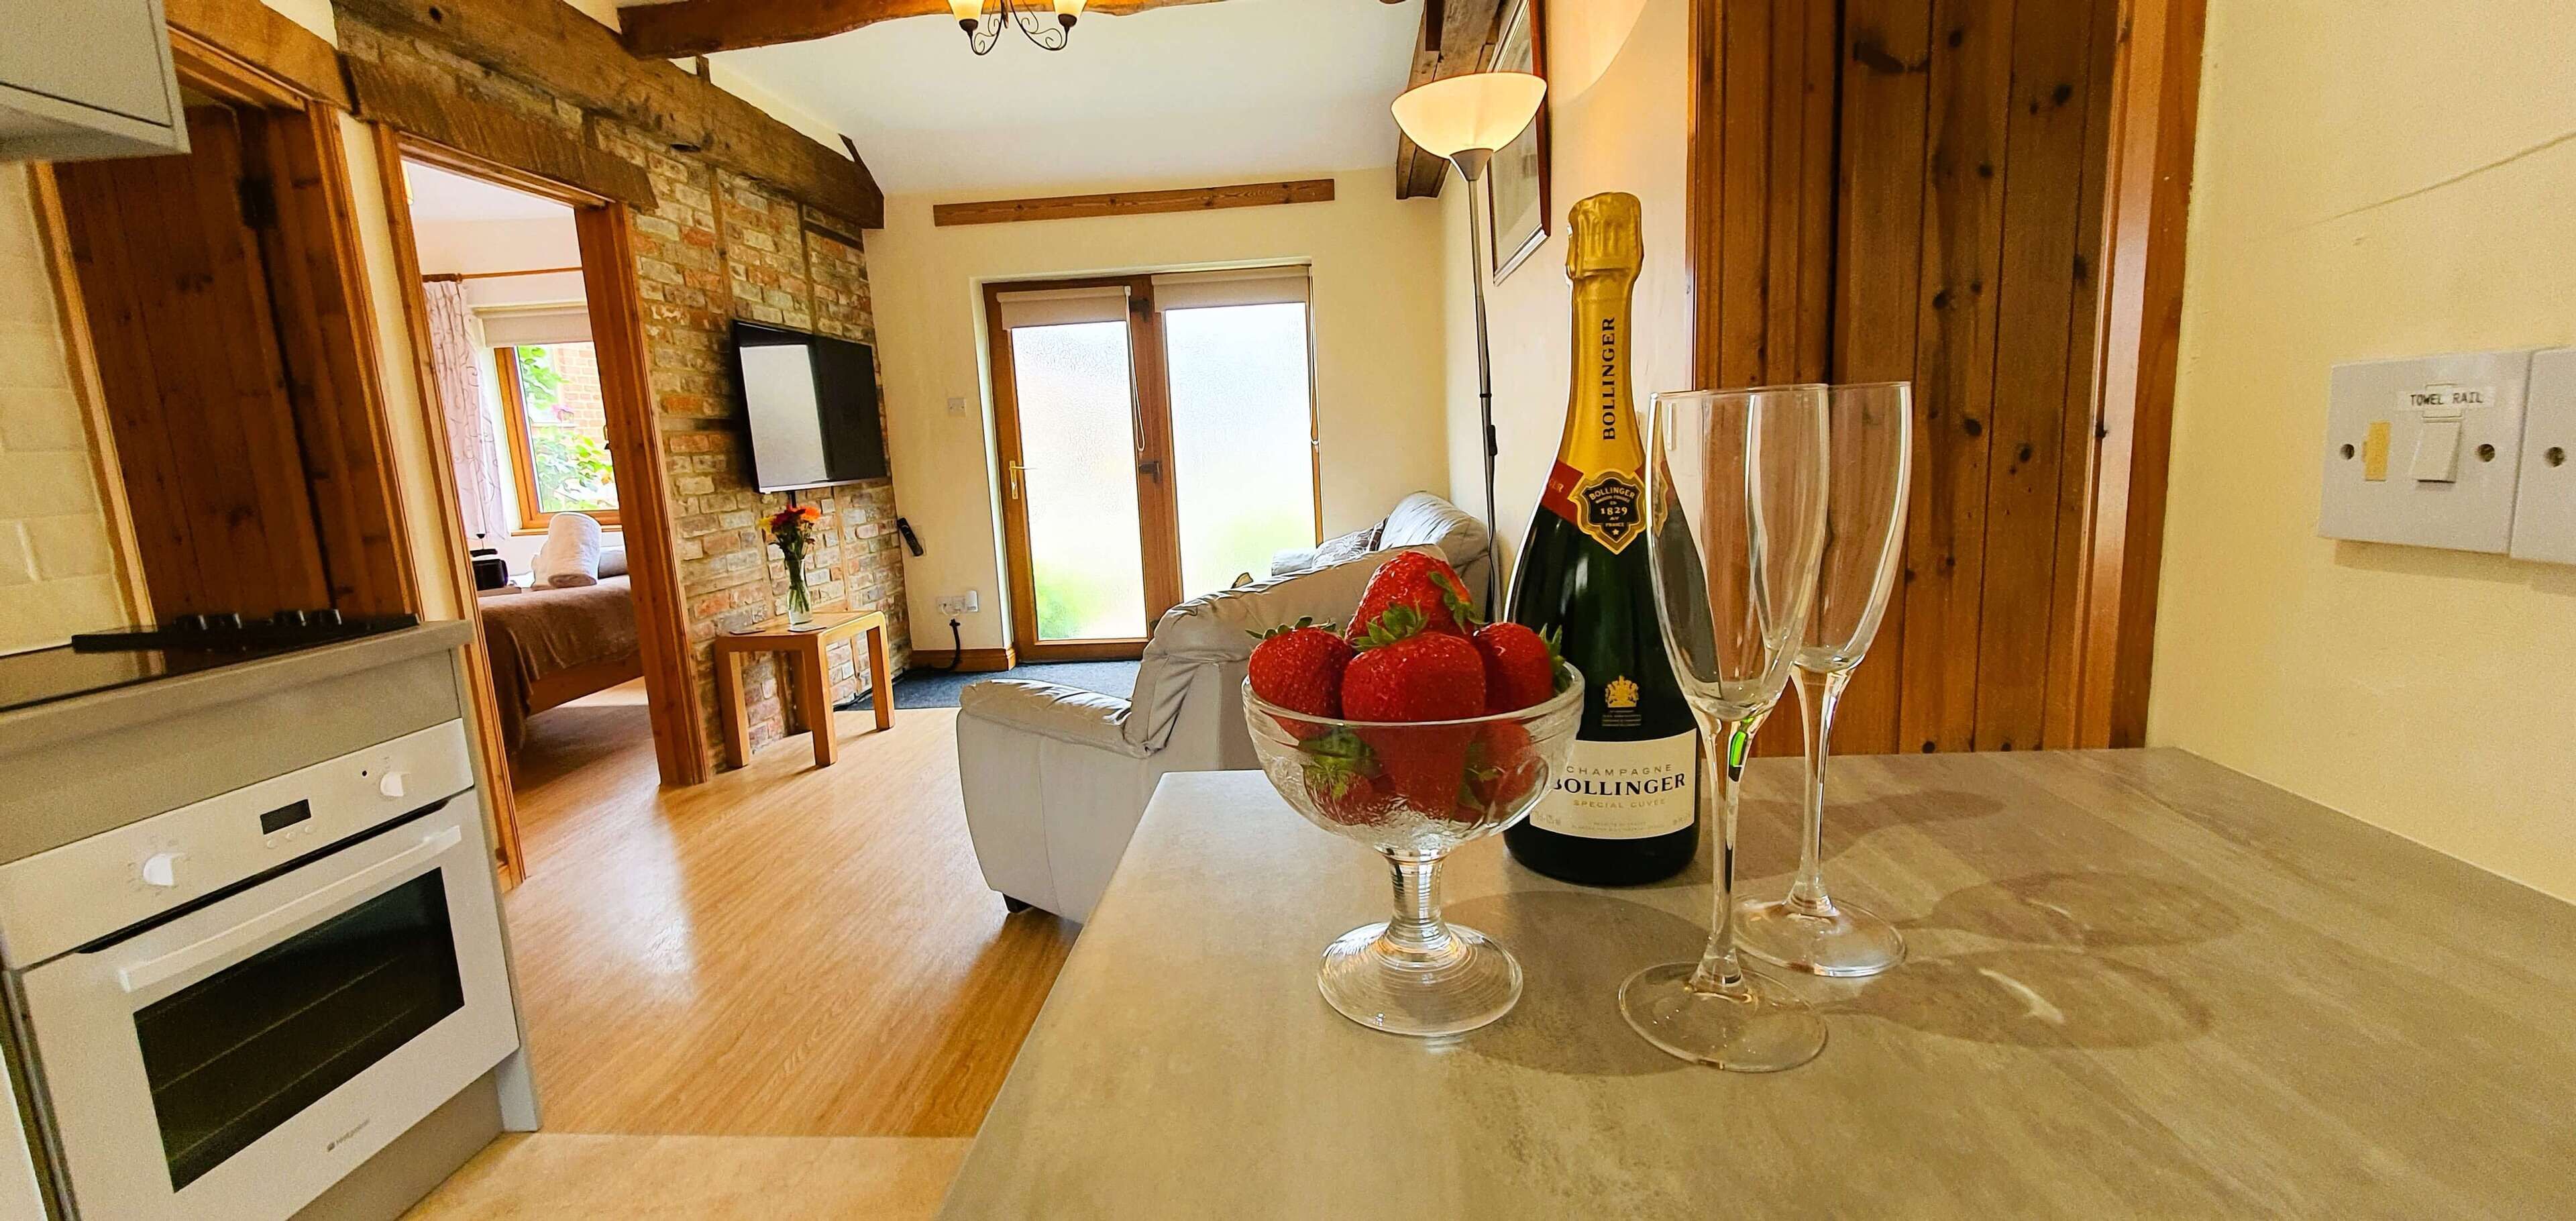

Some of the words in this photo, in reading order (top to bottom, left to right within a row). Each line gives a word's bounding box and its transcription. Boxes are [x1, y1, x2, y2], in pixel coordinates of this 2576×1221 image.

[1601, 317, 1615, 441] BOLLINGER
[2410, 394, 2445, 406] TOWEL
[2453, 392, 2483, 404] RAIL
[1589, 487, 1635, 500] BOLLINGER
[1601, 507, 1628, 515] 1829
[1566, 764, 1672, 776] CHAMPAGNE
[1573, 800, 1623, 808] SPECIAL
